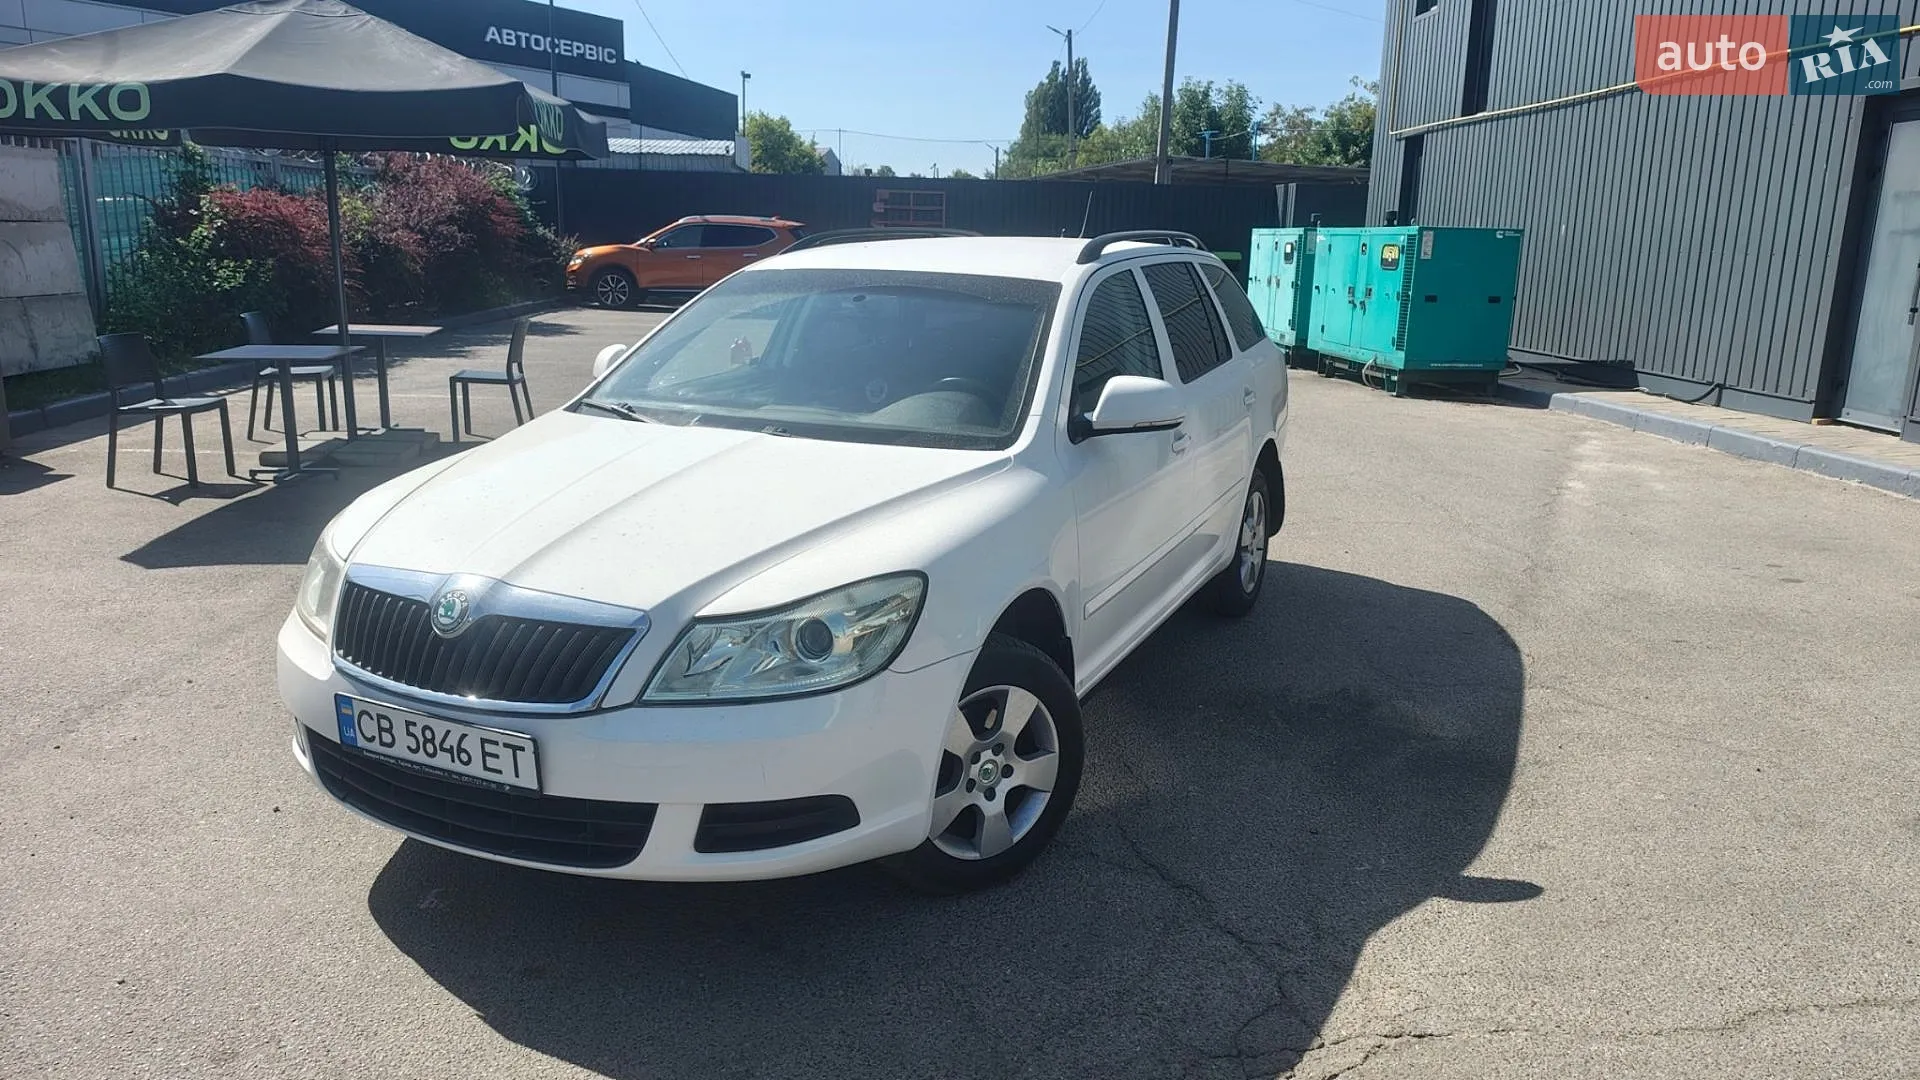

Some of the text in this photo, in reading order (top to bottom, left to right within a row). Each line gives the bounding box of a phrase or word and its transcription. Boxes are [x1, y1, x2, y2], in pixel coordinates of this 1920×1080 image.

[484, 26, 617, 64] АВТОСЕРВІС
[356, 710, 396, 748] CB
[404, 719, 472, 766] 5846
[480, 737, 525, 778] ET
